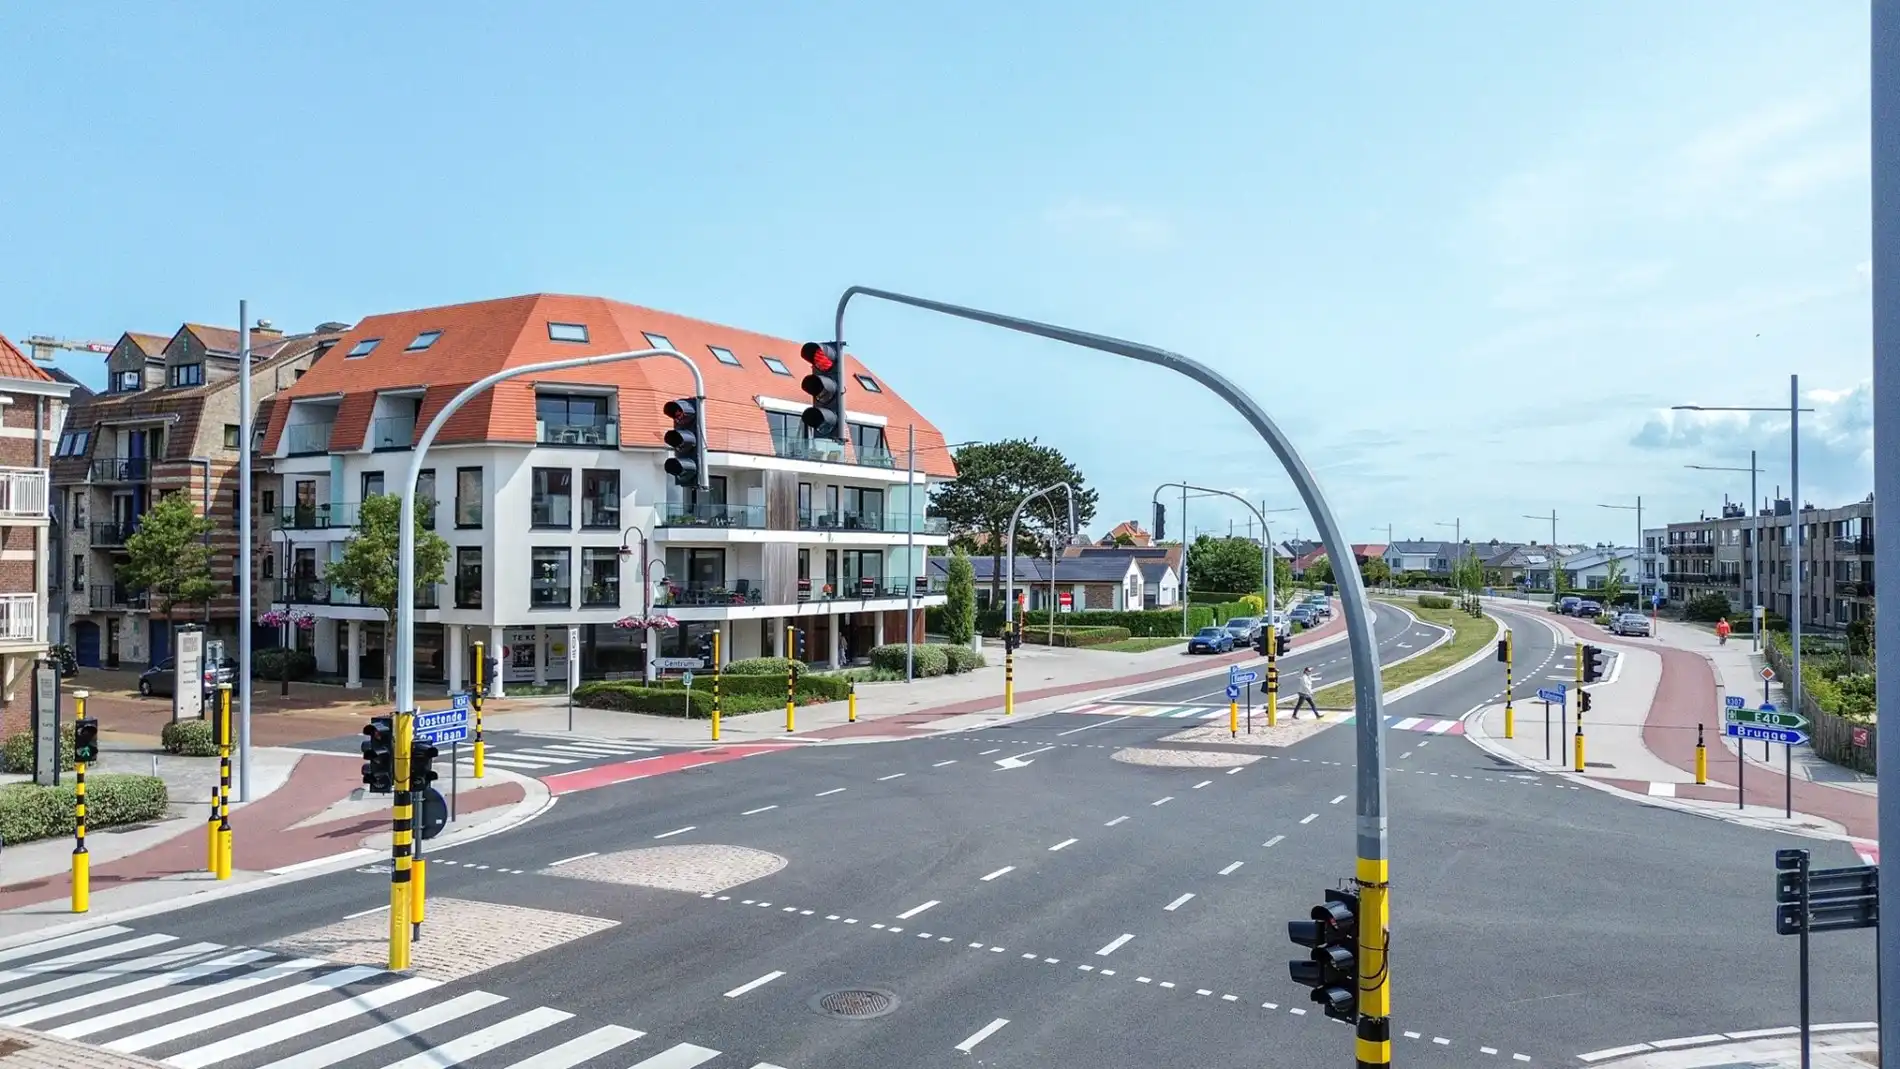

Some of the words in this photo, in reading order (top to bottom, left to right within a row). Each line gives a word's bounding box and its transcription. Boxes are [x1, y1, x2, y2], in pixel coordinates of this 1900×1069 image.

[526, 633, 549, 641] KOP
[664, 659, 695, 667] Centrum
[418, 711, 463, 728] Oostende
[1754, 713, 1780, 724] E40
[436, 730, 461, 742] Haan
[1737, 726, 1788, 741] Brugge
